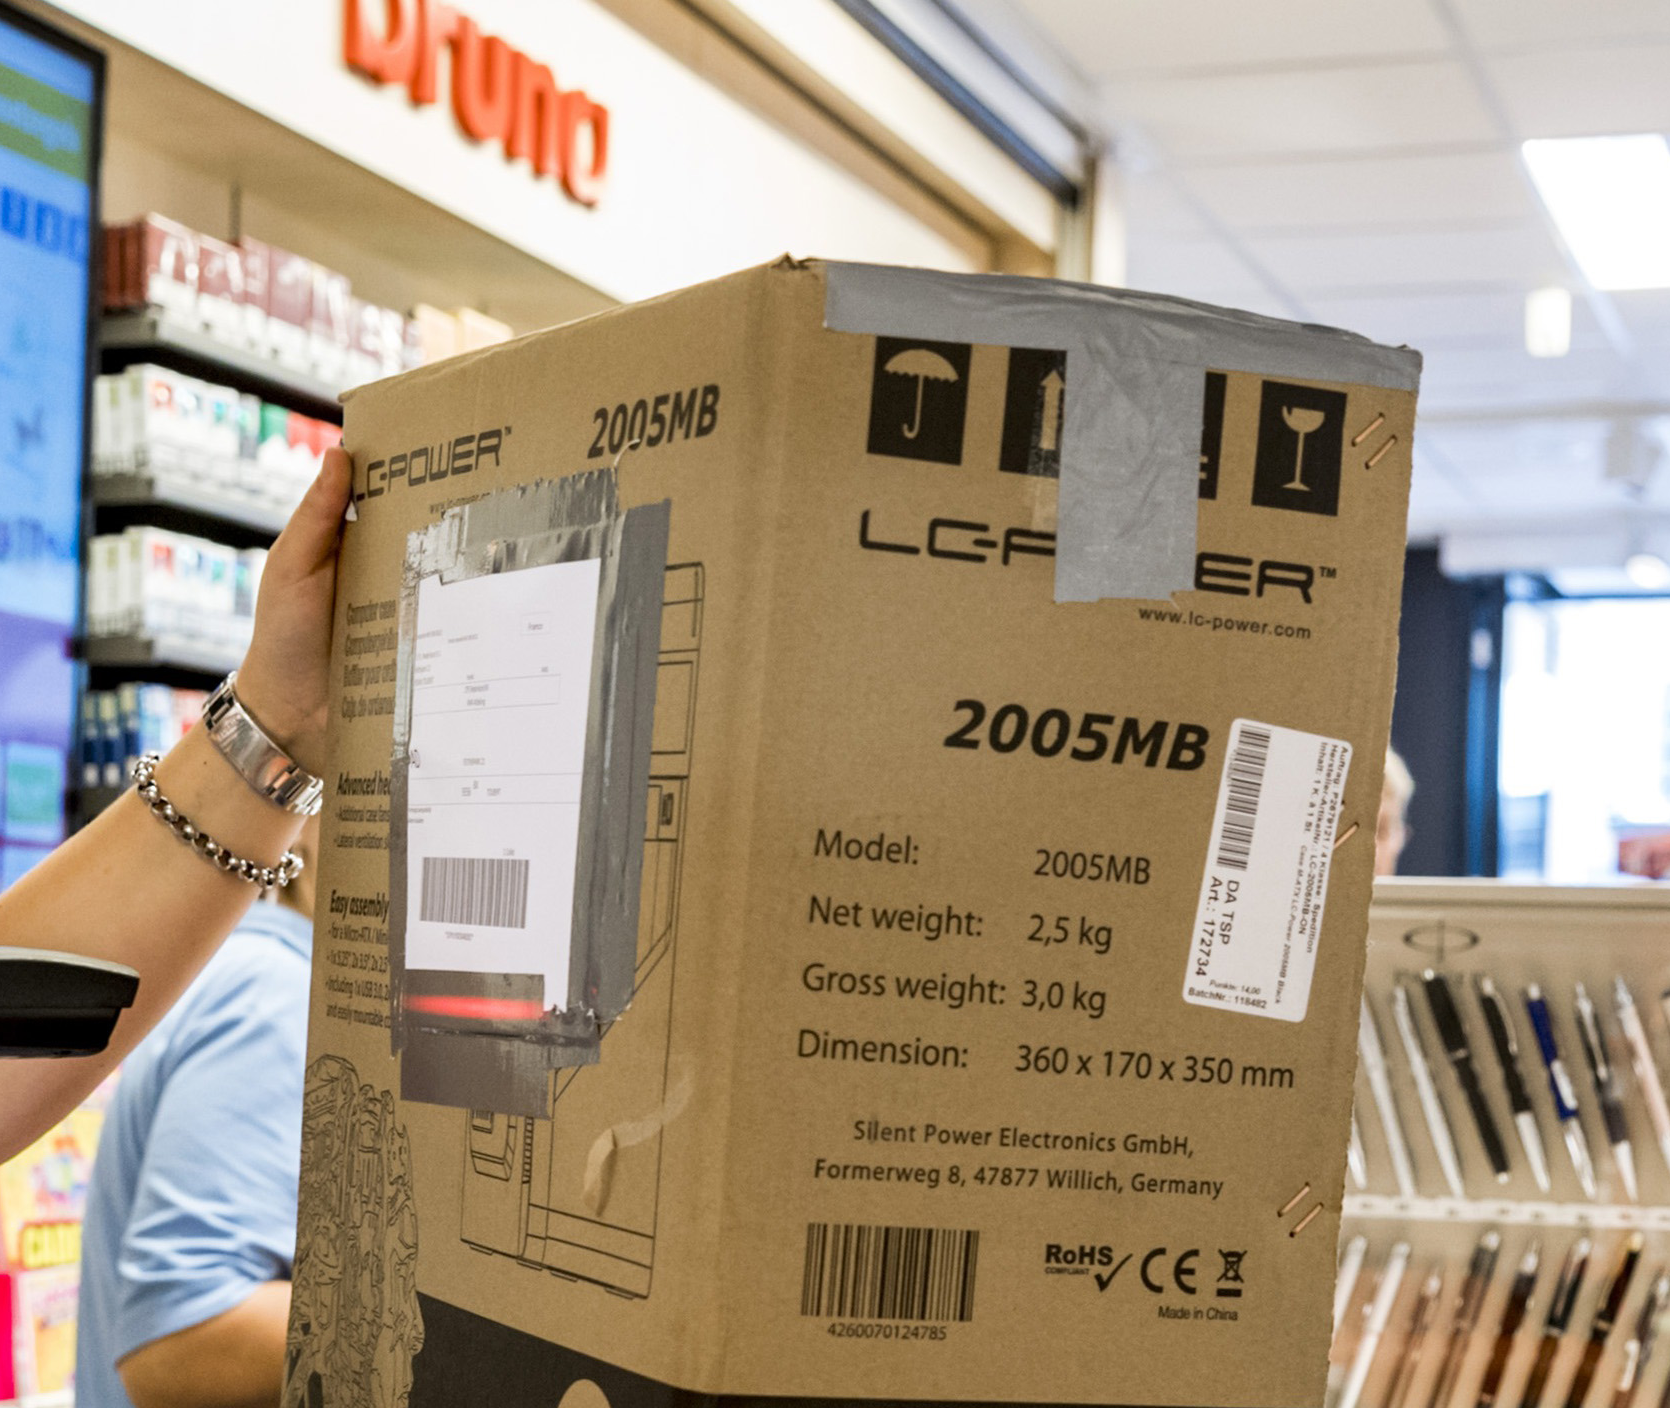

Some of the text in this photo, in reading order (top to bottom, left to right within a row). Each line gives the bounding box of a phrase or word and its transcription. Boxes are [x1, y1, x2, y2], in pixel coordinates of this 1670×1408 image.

[588, 384, 721, 460] 2005MB
[1138, 608, 1312, 641] www.lc-power.com
[943, 699, 1210, 772] 2005MB
[336, 770, 377, 796] Advanced
[813, 828, 1152, 886] Model: 2005MB
[330, 889, 390, 924] Easy assembly
[809, 895, 1113, 955] Net weight: 2,5 kg
[1193, 875, 1223, 977] Art.: 172734
[1216, 879, 1240, 945] DA TSP
[1304, 902, 1321, 954] Spedition
[802, 962, 1107, 1020] Gross weight: 3,0 kg
[797, 1028, 1295, 1089] Dimension: 360 x 170 x 350 mm
[853, 1120, 1195, 1159] Silent Power Electronics GmbH,
[814, 1158, 1224, 1201] Formerweg 8, 47877 Willich, Germany
[1045, 1244, 1113, 1266] RoHS
[1045, 1266, 1090, 1276] COMPLIANT
[1140, 1247, 1200, 1295] CE
[827, 1322, 947, 1341] 4260070124785
[1158, 1306, 1238, 1321] Made in China
